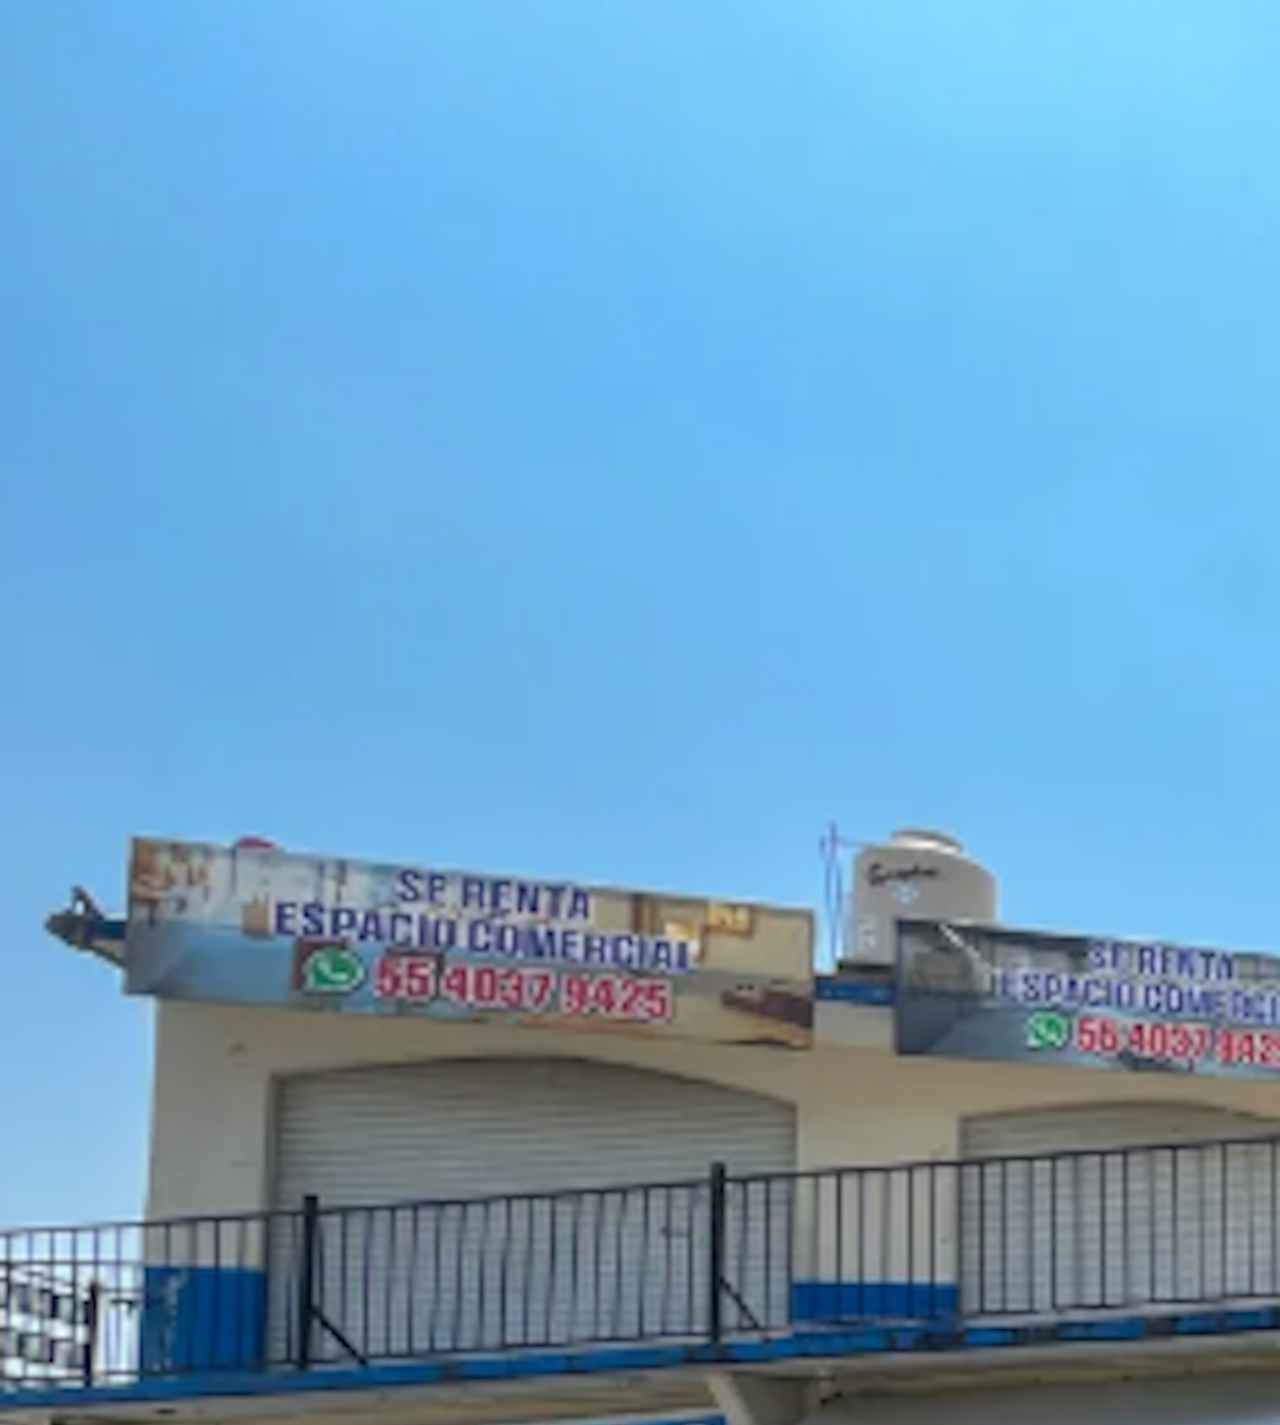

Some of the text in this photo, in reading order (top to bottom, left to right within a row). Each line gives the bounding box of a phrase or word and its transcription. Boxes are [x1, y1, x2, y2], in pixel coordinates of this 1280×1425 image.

[399, 869, 592, 921] SE RENTA
[274, 902, 690, 973] ESPACIO COMERCIAL
[375, 956, 672, 1021] 55 4037 9425
